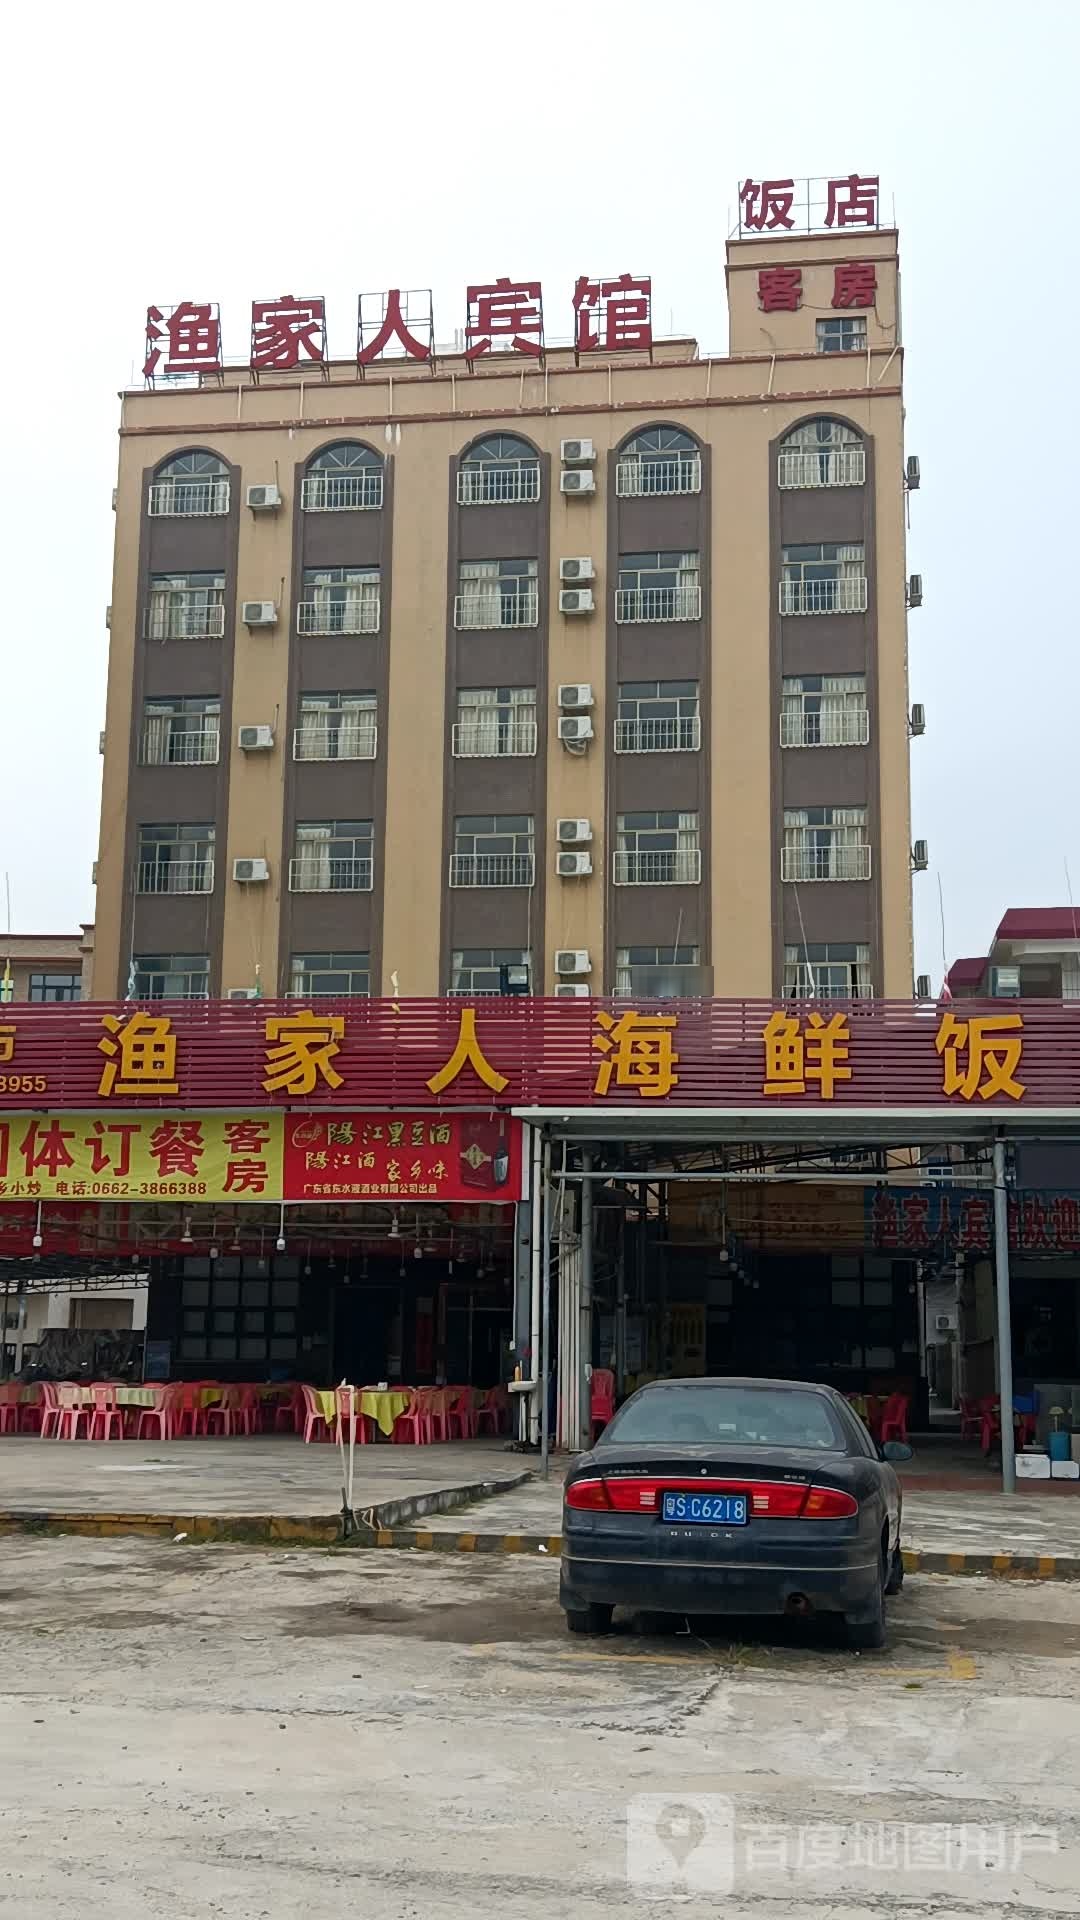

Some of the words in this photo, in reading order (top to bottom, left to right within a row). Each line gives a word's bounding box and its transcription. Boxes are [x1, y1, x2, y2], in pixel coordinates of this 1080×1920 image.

[740, 175, 879, 230] 饭店
[757, 263, 878, 312] 客房
[143, 273, 652, 376] 渔家人宾馆
[96, 1008, 1028, 1101] 渔家人海鲜饭
[0, 1120, 205, 1178] 体订餐
[222, 1119, 271, 1194] 客房
